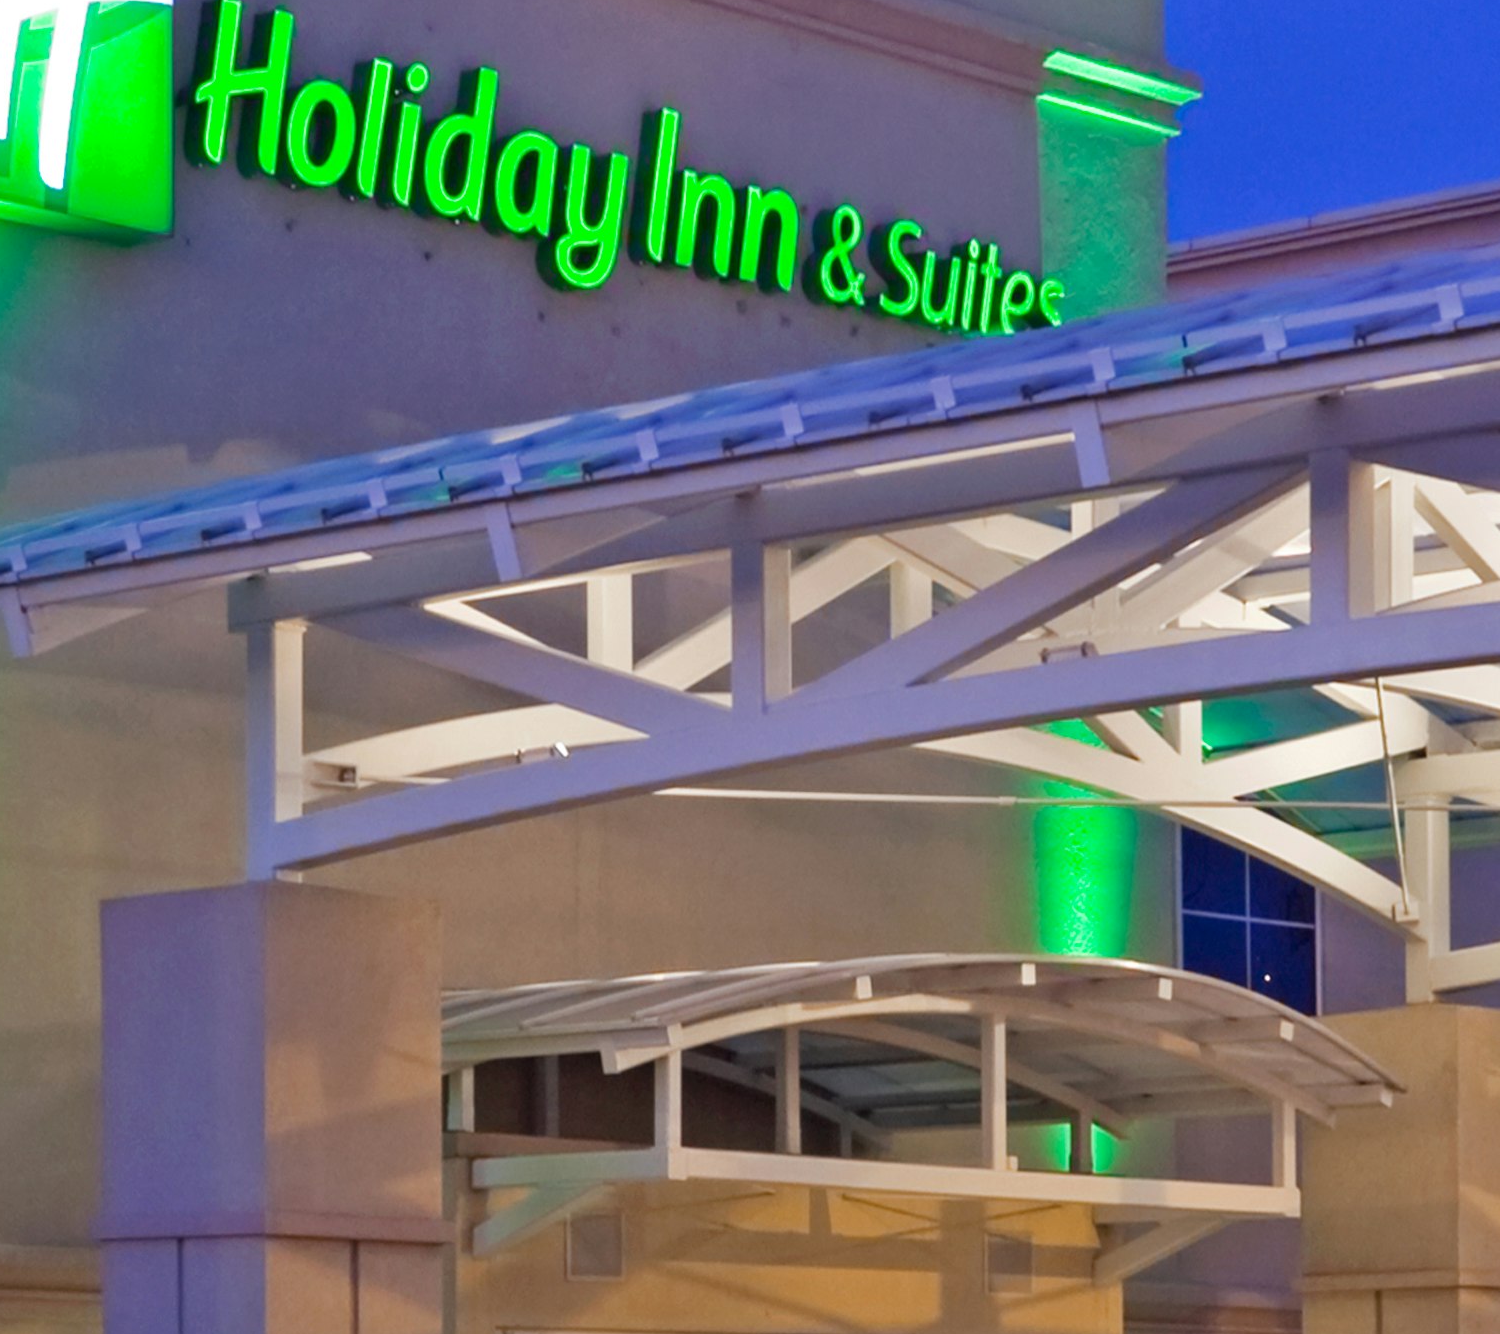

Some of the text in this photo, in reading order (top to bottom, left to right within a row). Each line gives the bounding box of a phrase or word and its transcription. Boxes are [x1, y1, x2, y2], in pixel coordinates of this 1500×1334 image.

[646, 106, 799, 292] Inn
[819, 203, 866, 308] &
[879, 219, 1066, 336] Suites
